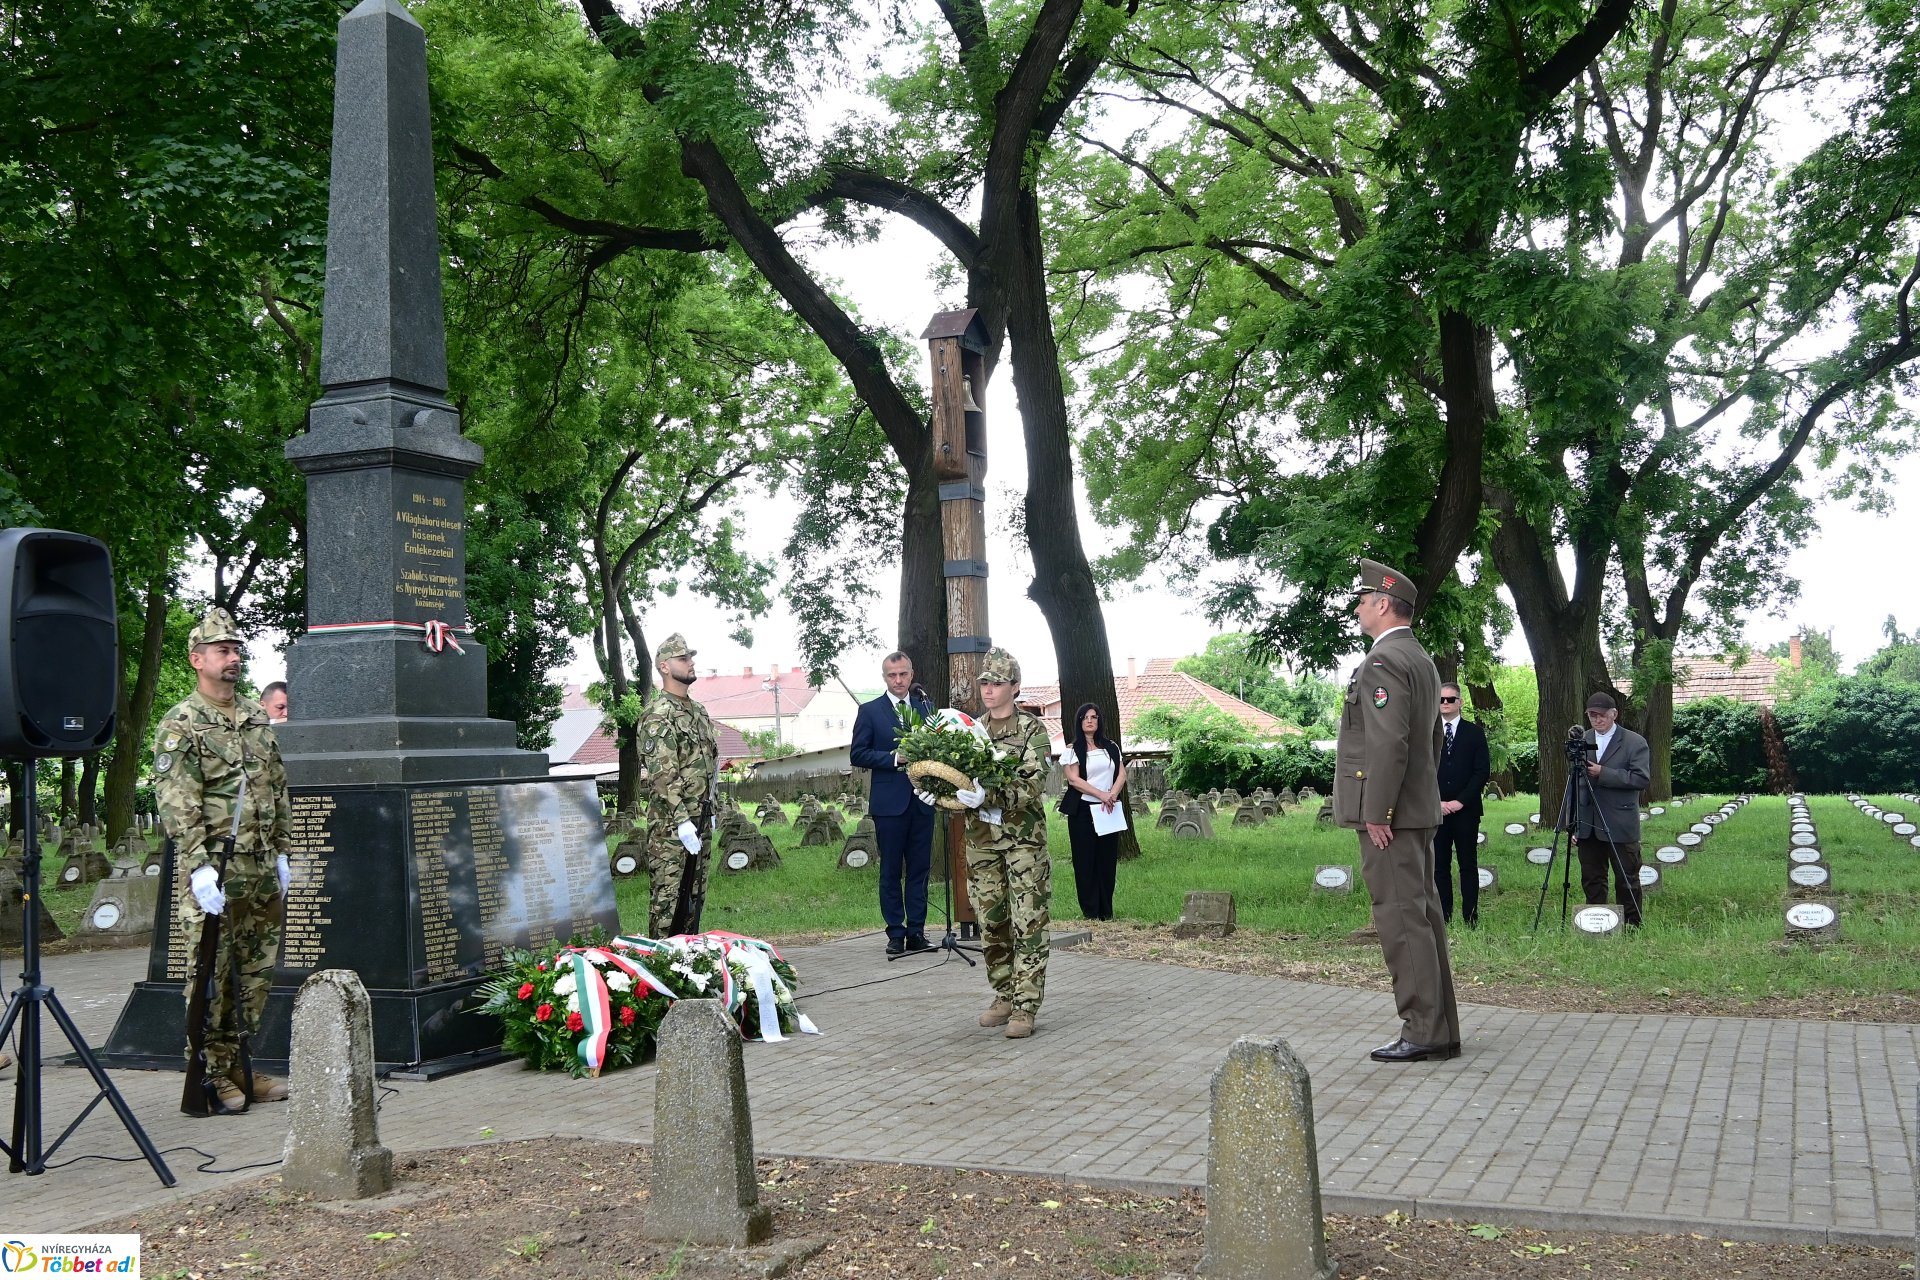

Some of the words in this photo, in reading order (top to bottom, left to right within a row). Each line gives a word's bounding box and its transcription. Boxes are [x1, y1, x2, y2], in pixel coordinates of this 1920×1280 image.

[412, 493, 426, 504] 1914
[396, 511, 401, 522] A
[412, 528, 446, 543] hőseinek
[400, 568, 428, 582] Szabolcs
[428, 571, 458, 586] vármegye
[396, 583, 404, 593] és
[404, 583, 444, 599] Nyíregyháza
[444, 587, 462, 599] város
